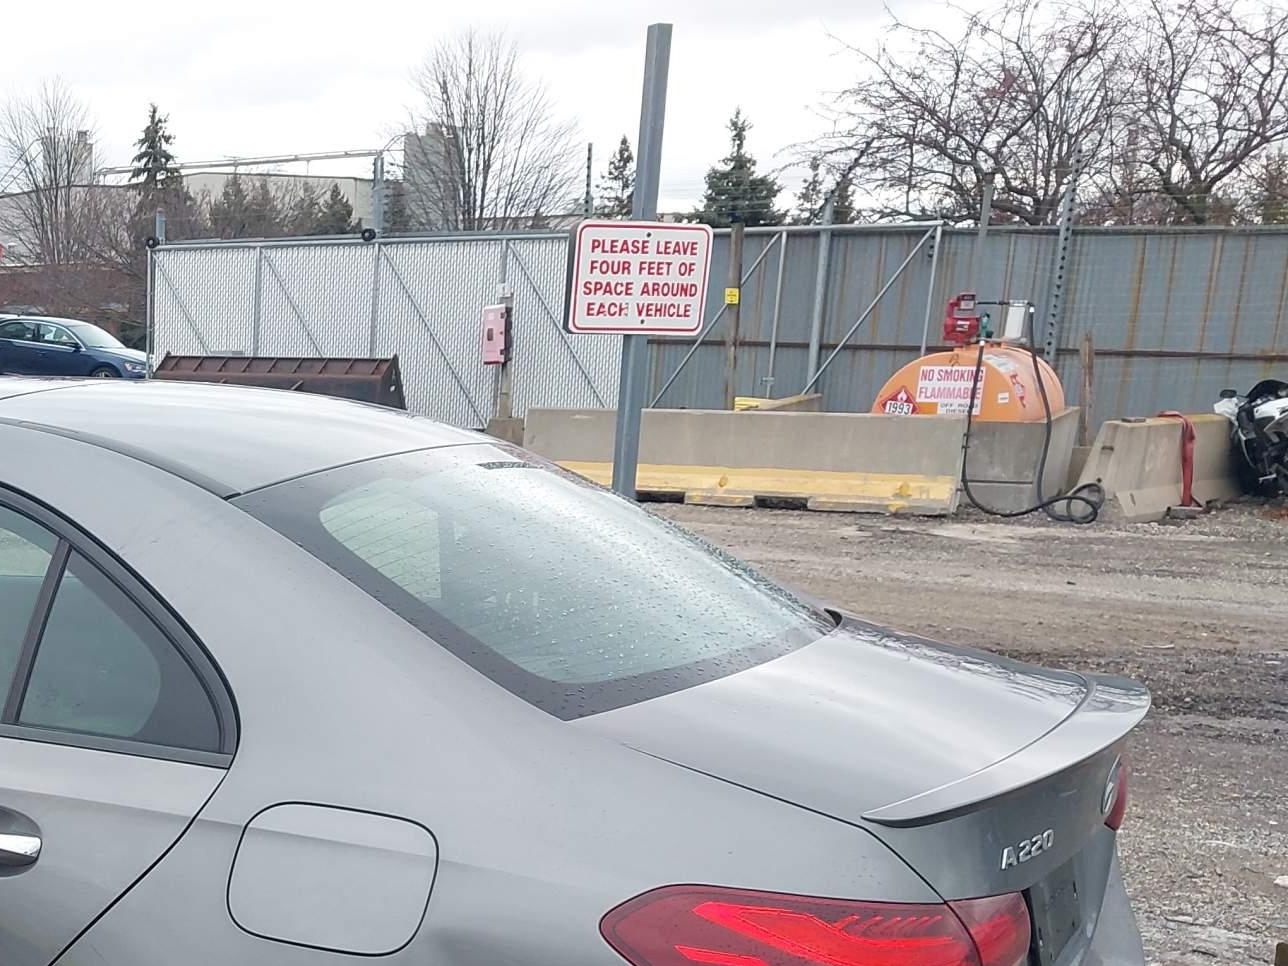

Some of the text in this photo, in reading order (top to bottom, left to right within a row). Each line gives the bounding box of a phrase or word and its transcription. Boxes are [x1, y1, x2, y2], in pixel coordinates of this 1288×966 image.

[591, 239, 698, 256] PLEASE LEAVE
[589, 260, 696, 276] FOUR FEET OF
[583, 281, 698, 297] SPACE AROUND
[586, 302, 692, 318] EACH VEHICLE
[920, 369, 934, 381] NO
[919, 387, 982, 400] FLAMMABE
[888, 402, 911, 415] 1993
